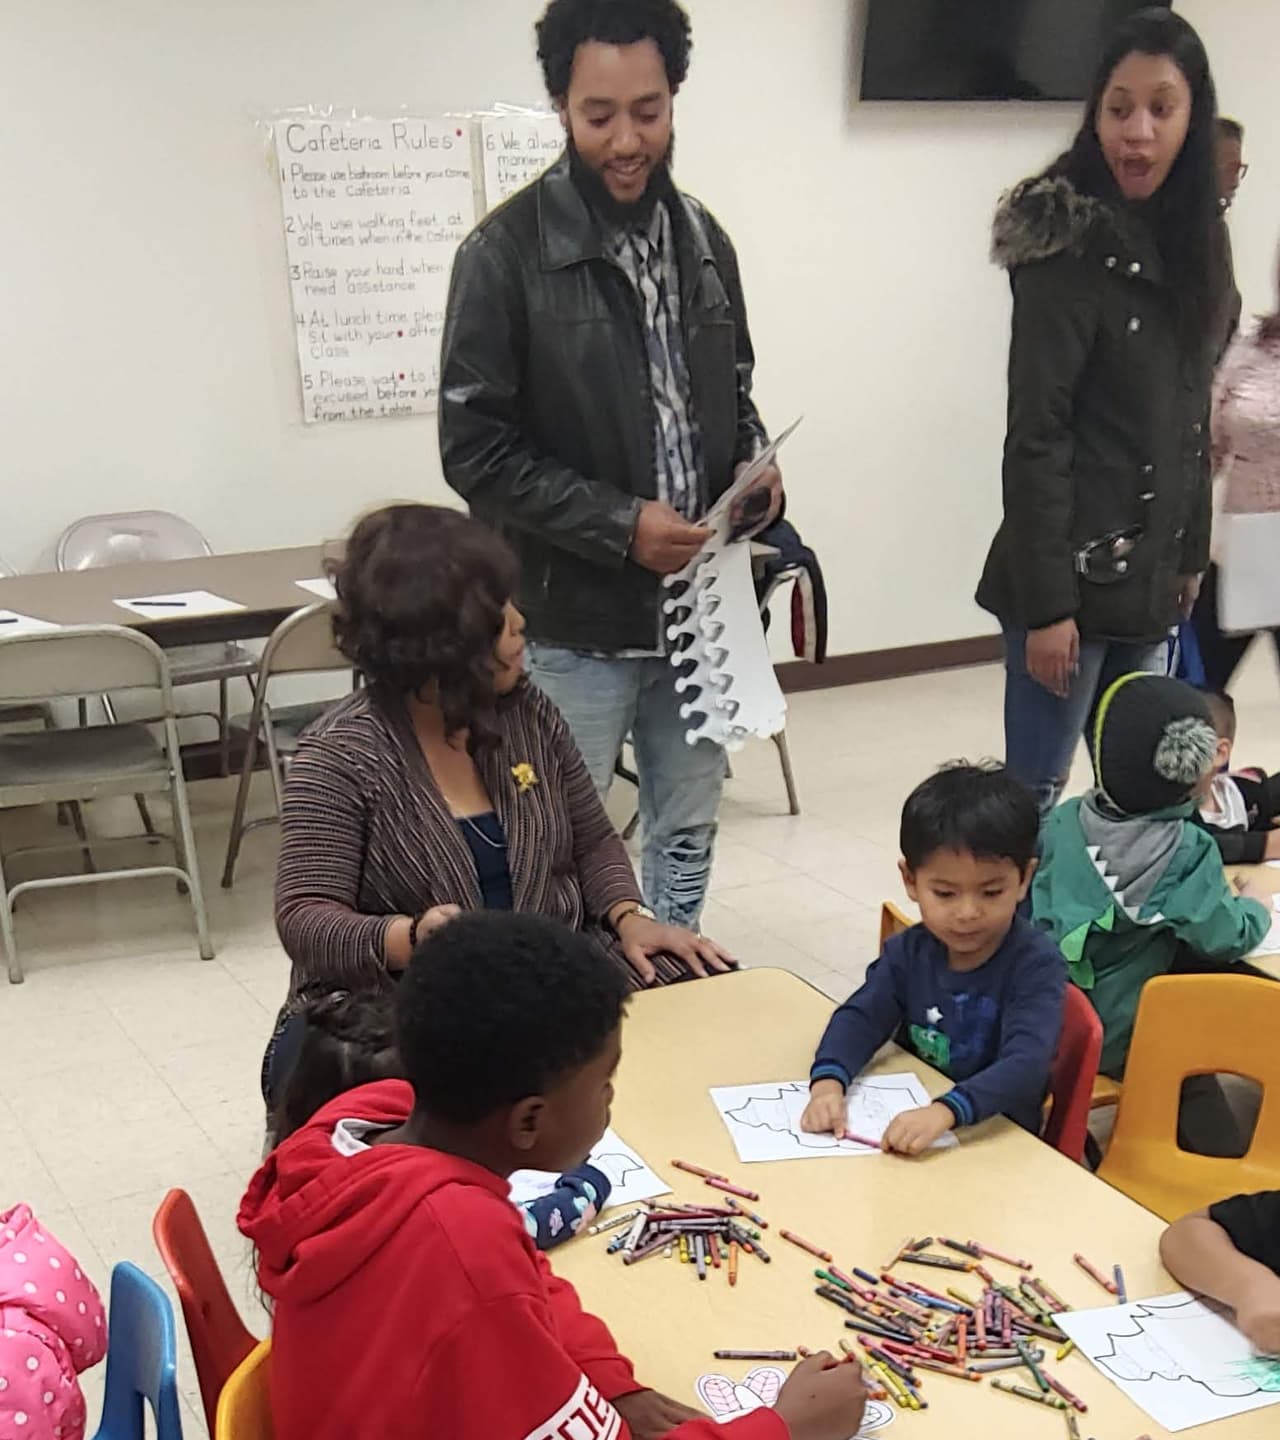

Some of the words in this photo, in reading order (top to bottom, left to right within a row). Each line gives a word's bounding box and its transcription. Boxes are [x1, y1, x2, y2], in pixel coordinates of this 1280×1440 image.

[286, 123, 382, 153] Cafeteria
[392, 122, 453, 151] Rules
[501, 130, 521, 150] We
[290, 163, 327, 182] Please
[331, 171, 346, 182] use
[392, 163, 422, 180] before
[425, 170, 443, 183] you
[293, 186, 308, 200] to
[314, 184, 336, 198] the
[286, 216, 295, 233] 2
[297, 212, 323, 233] We
[330, 217, 353, 230] use
[357, 211, 405, 232] walking
[409, 209, 437, 226] feet
[447, 211, 464, 226] at
[297, 232, 315, 247] all
[319, 233, 355, 246] times
[359, 231, 390, 246] when
[289, 264, 301, 280] 3
[303, 261, 337, 280] Raise
[345, 267, 370, 283] your
[376, 257, 405, 276] hand
[410, 257, 444, 275] when
[305, 279, 337, 295] need
[347, 280, 416, 295] assistance
[296, 312, 305, 328] 4
[309, 309, 329, 328] At
[335, 305, 370, 326] lunch
[375, 308, 407, 325] time
[333, 327, 363, 342] with
[368, 329, 395, 345] your
[304, 374, 313, 390] 5
[319, 370, 367, 387] Please
[410, 371, 426, 383] to
[313, 386, 369, 404] excused
[377, 385, 417, 400] before
[313, 406, 346, 422] from
[351, 406, 374, 418] the
[380, 404, 413, 417] table
